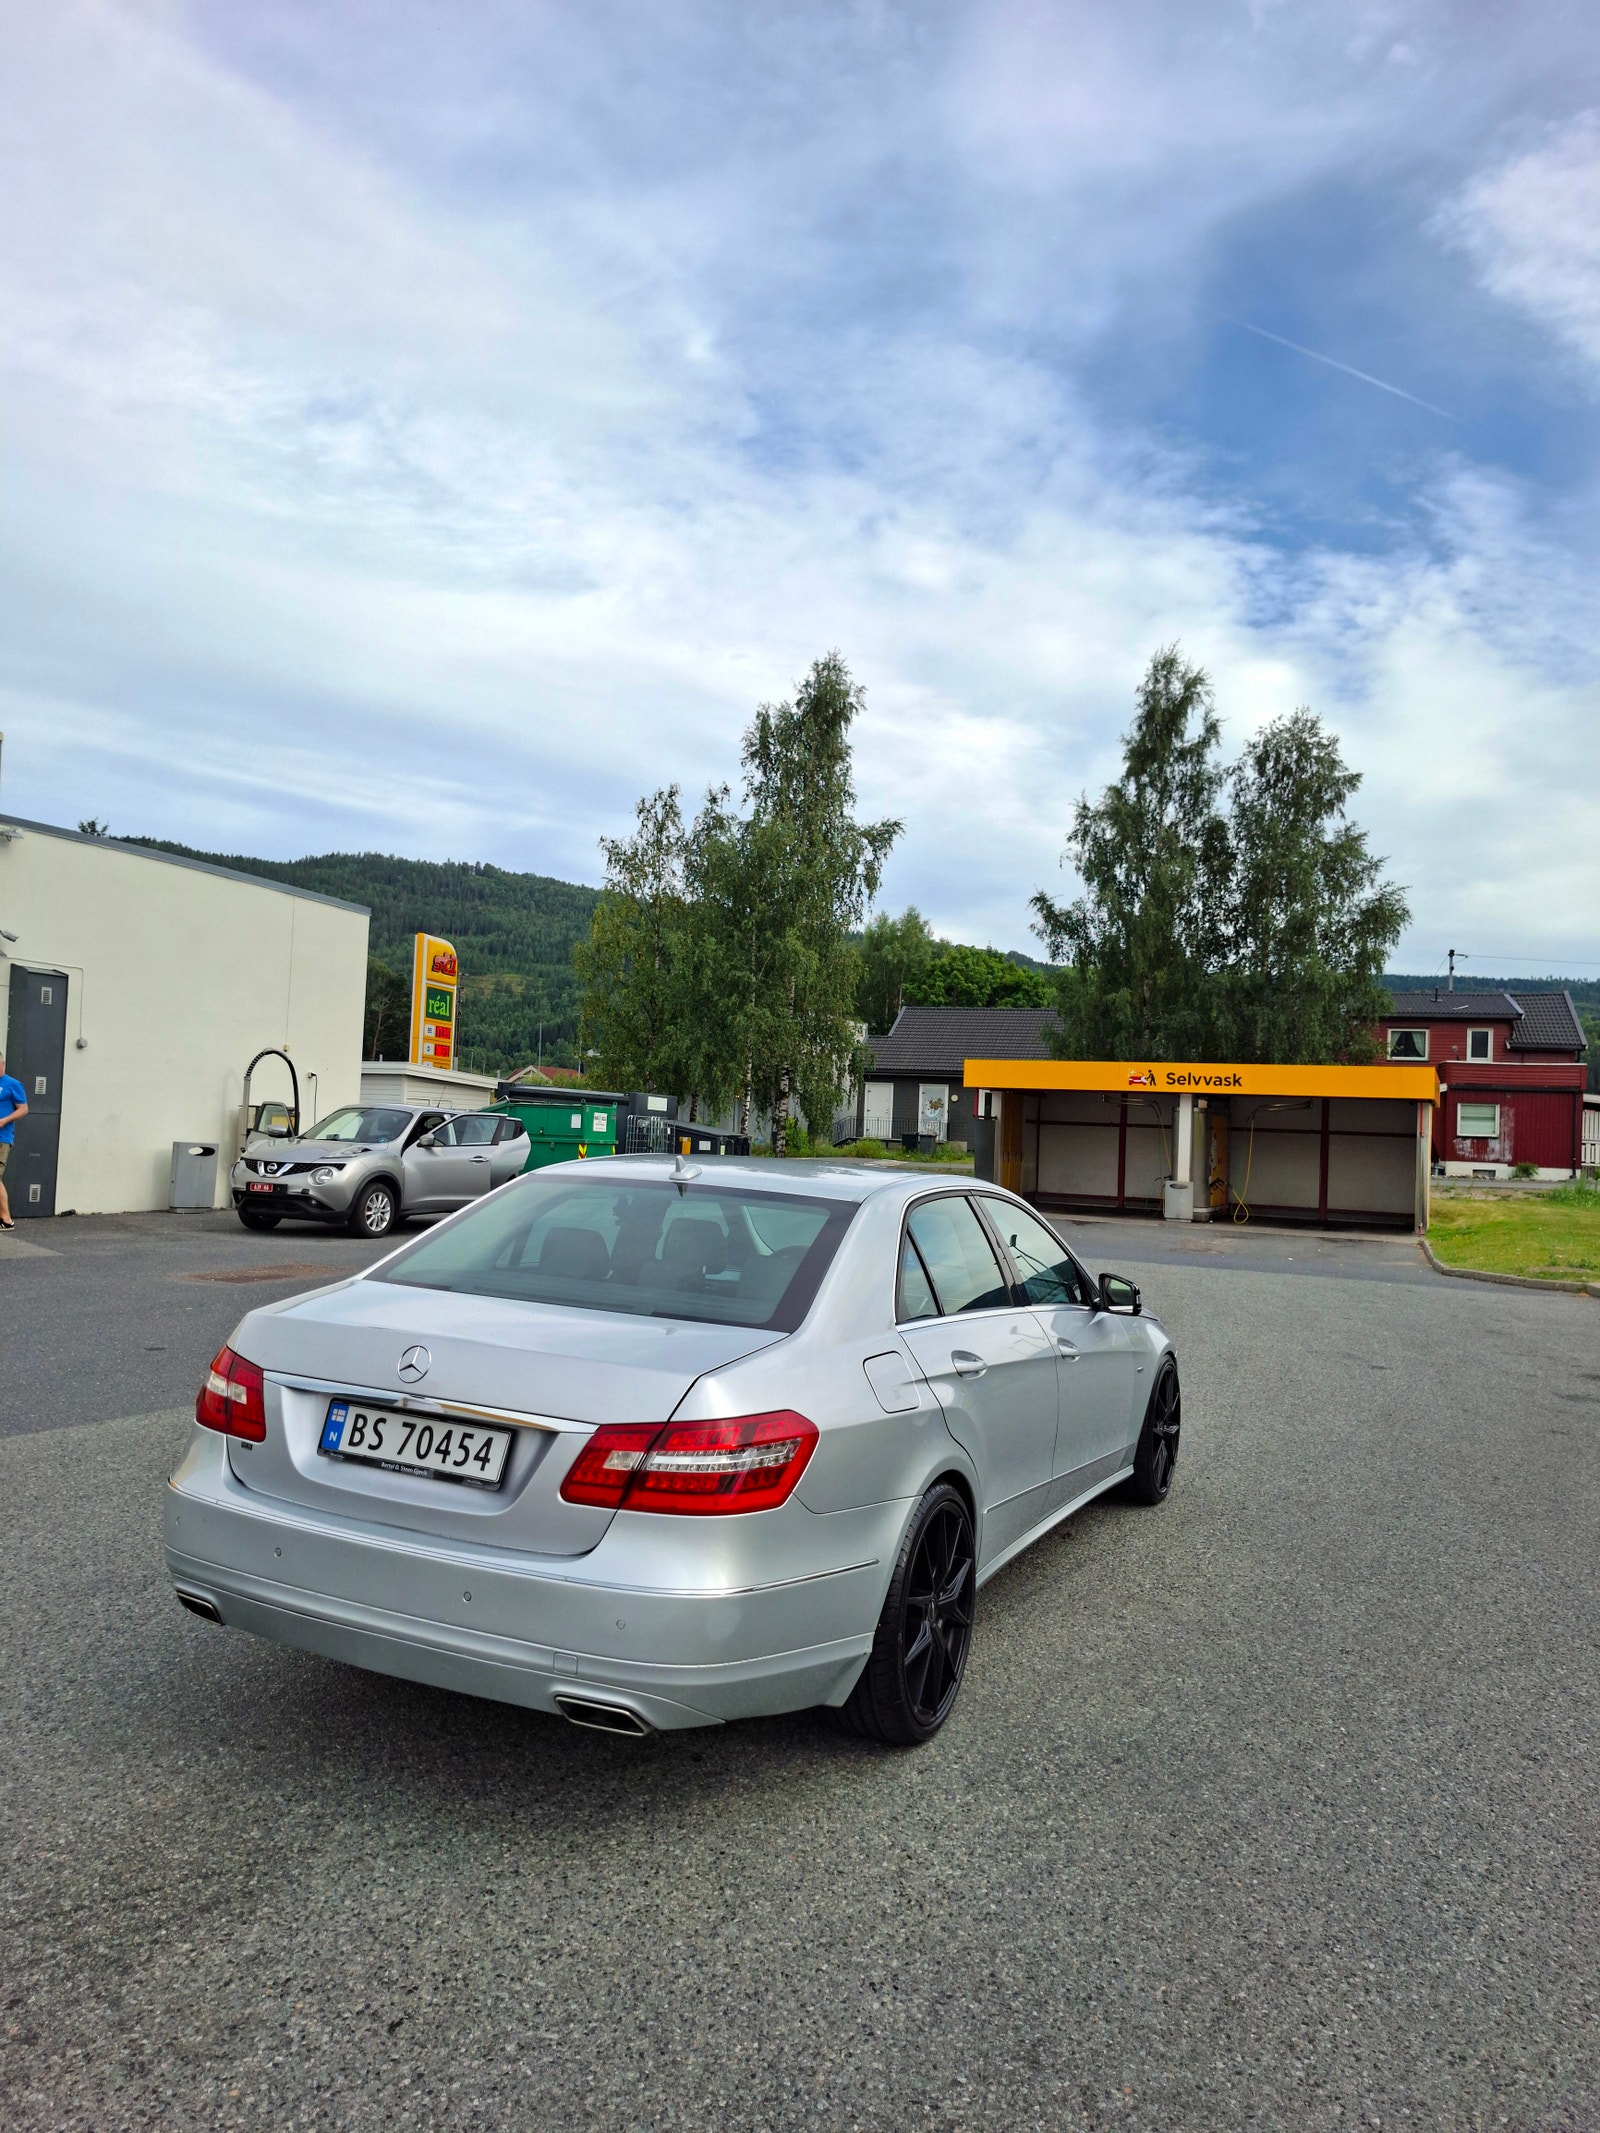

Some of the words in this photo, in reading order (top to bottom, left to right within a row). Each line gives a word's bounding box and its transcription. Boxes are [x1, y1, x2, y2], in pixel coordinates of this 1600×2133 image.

[1166, 1072, 1242, 1087] Selvvask
[328, 1431, 338, 1442] N
[348, 1413, 387, 1451] BS
[396, 1422, 494, 1472] 70454
